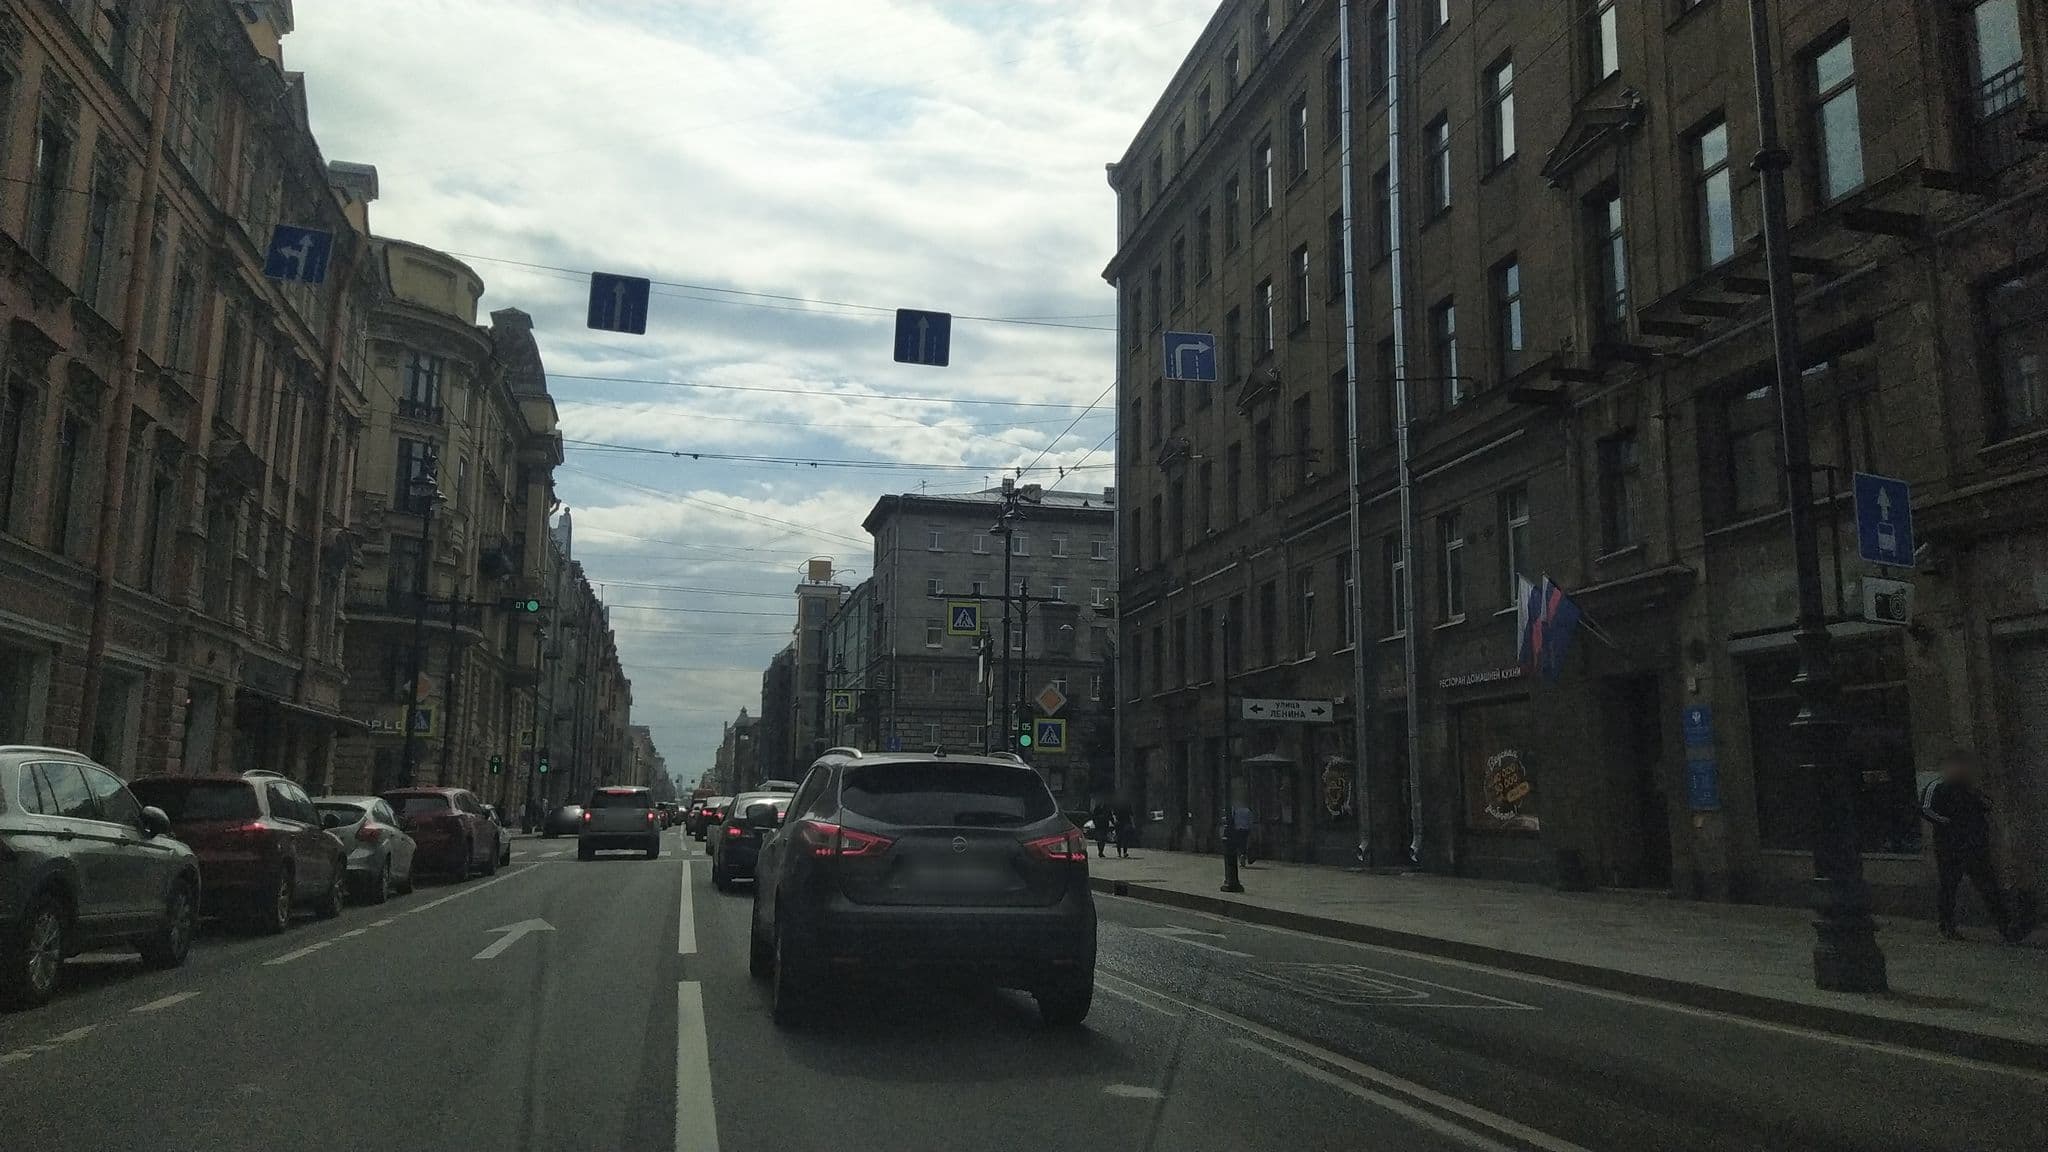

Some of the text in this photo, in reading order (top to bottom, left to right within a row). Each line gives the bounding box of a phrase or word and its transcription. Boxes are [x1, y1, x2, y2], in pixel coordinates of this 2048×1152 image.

[1439, 666, 1521, 689] РЕСТОРАН ДОМАШНЕЙ КУХНИ
[1270, 709, 1306, 718] ЛЕНИНА
[1021, 722, 1032, 731] 05
